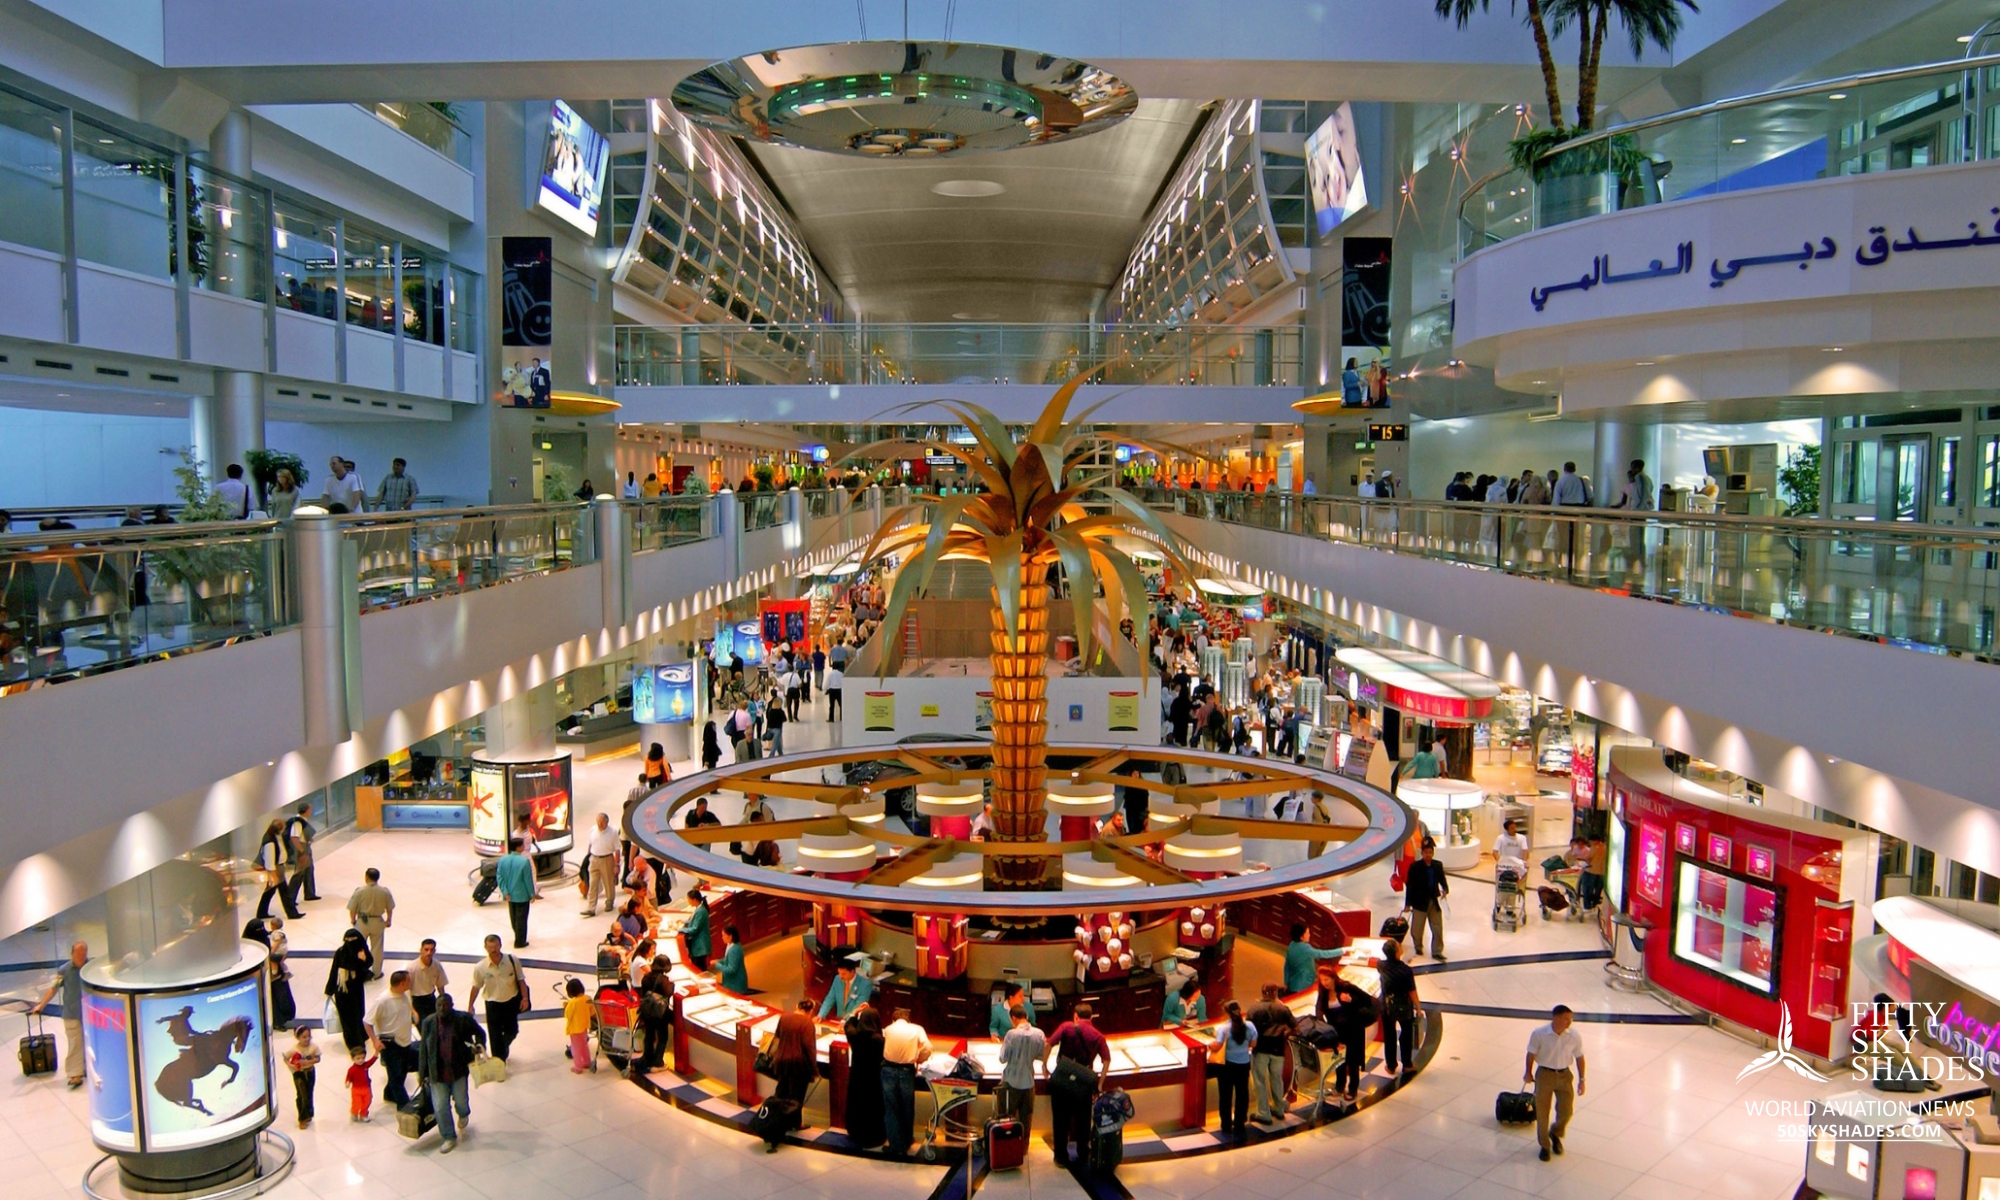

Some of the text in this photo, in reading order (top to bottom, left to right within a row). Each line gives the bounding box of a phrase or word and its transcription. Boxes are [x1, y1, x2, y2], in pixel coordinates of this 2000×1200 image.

[1530, 241, 1693, 312] العالمي
[1711, 236, 1837, 288] دبي
[1381, 426, 1393, 440] 15
[1943, 1001, 2000, 1050] perf
